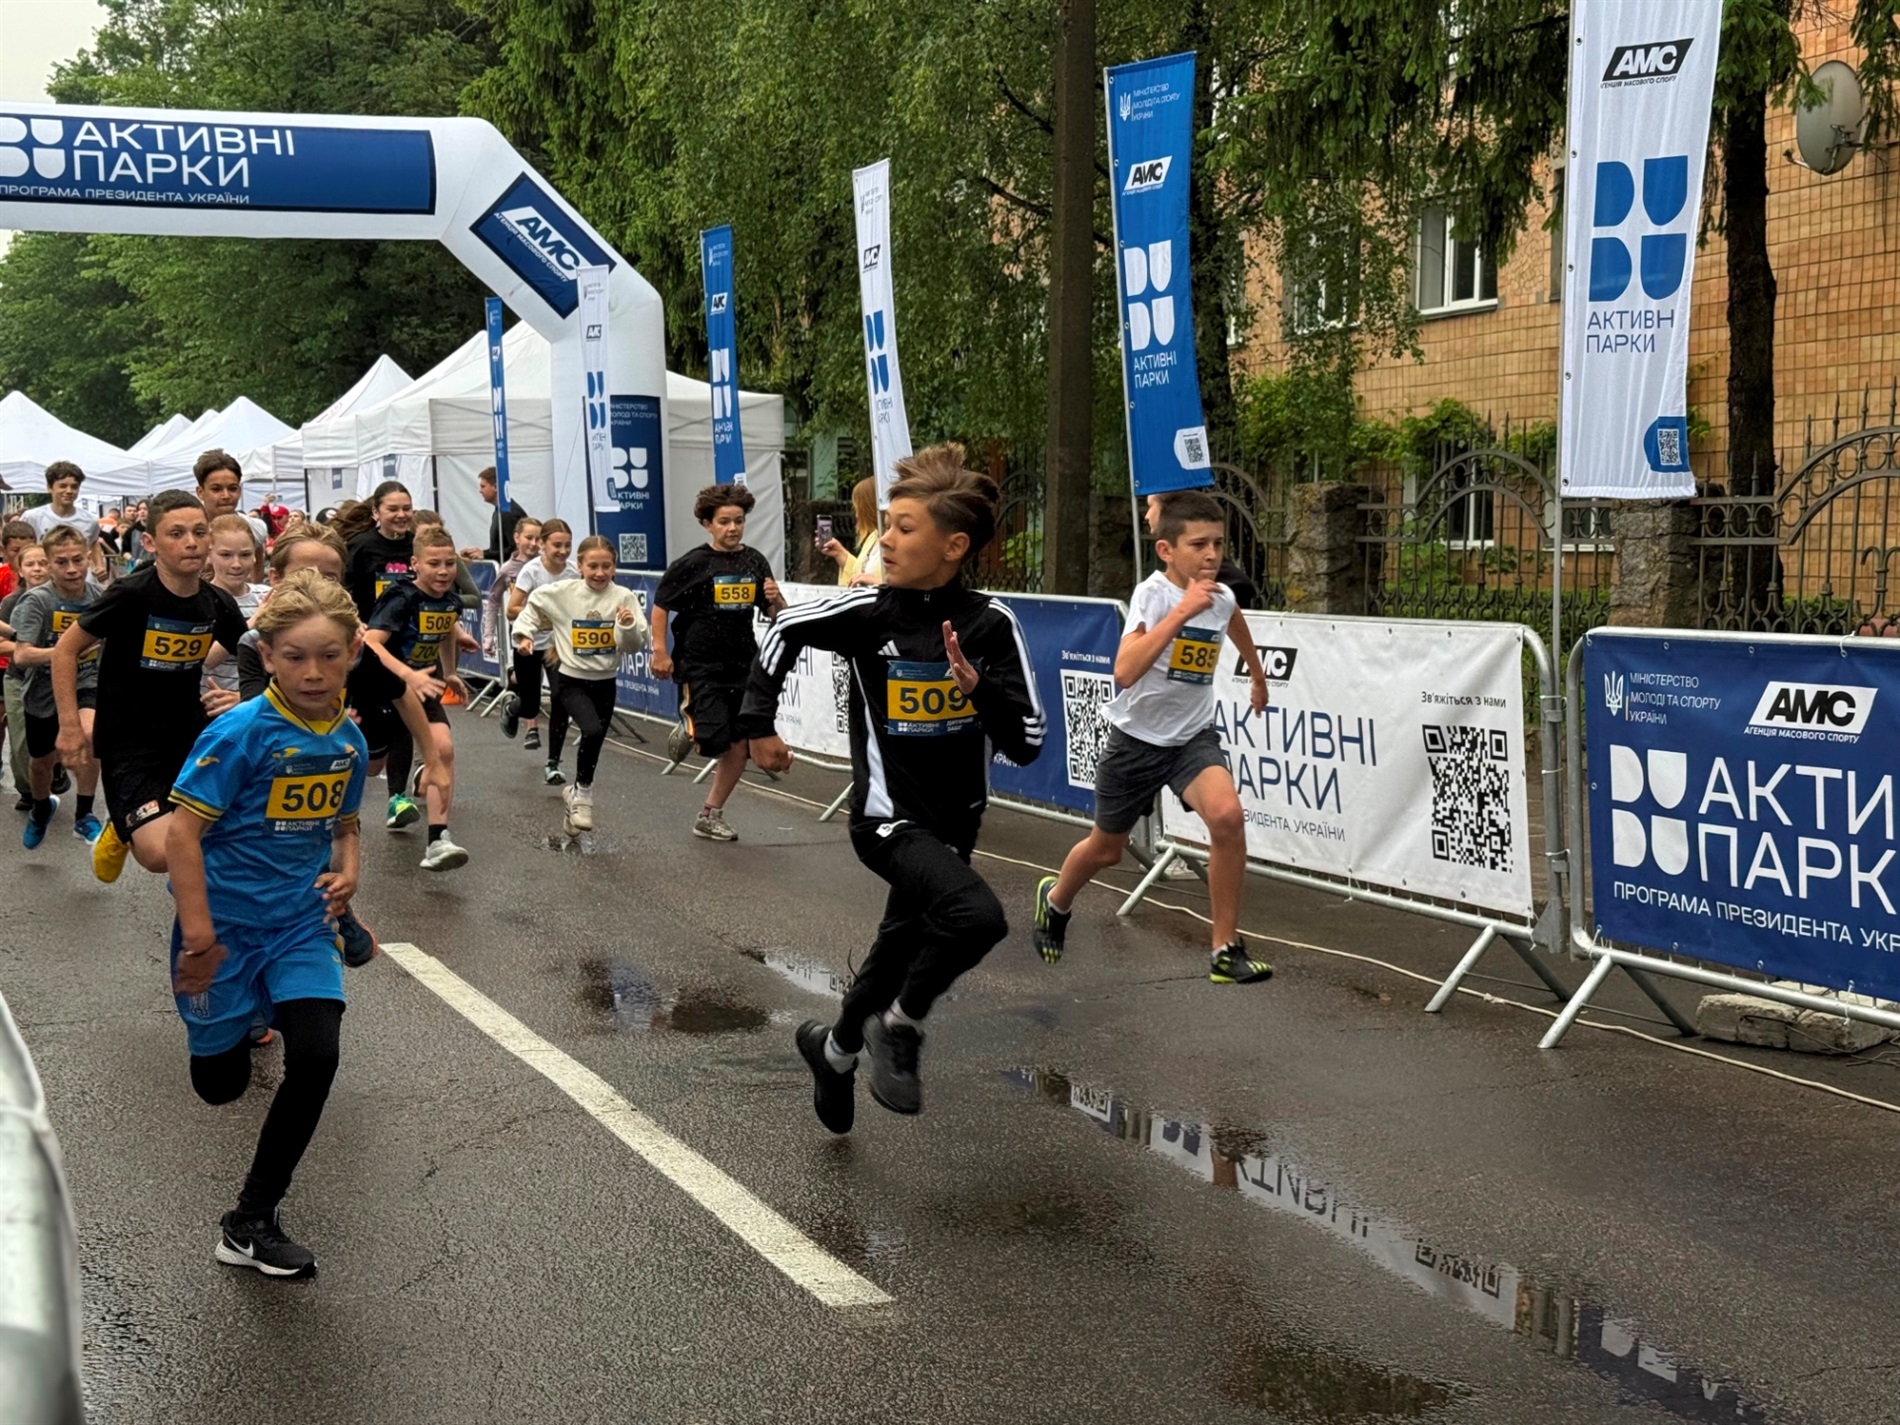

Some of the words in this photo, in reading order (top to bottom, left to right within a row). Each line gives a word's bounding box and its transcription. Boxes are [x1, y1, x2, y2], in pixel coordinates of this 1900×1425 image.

[1612, 44, 1678, 77] АМС
[73, 121, 295, 156] АКТИВНІ
[74, 149, 250, 188] ПАРКИ
[0, 184, 81, 199] ПРОГРАМА
[84, 188, 185, 203] ПРЕЗИДЕНТА
[187, 191, 250, 205] УКРАЇНИ
[514, 216, 580, 272] АМС
[1585, 333, 1656, 354] ПАРКИ
[1133, 350, 1178, 371] АКТИВНІ
[1134, 369, 1170, 389] ПАРКИ
[617, 490, 650, 501] КТИВНІ
[618, 501, 644, 511] АРКИ
[720, 586, 751, 601] 558
[425, 615, 452, 631] 508
[153, 635, 203, 658] 529
[577, 631, 612, 646] 590
[1179, 644, 1218, 669] 585
[1629, 672, 1700, 689] МІНІСТЕРСТВО
[899, 685, 968, 716] 509
[1421, 690, 1474, 706] Зв'яжіться
[1474, 695, 1482, 706] з
[1483, 696, 1507, 708] нами
[1630, 691, 1665, 707] МОЛОДІ
[1665, 693, 1680, 707] ТА
[1680, 695, 1722, 711] СПОРТУ
[1764, 687, 1857, 728] АМС
[1628, 709, 1668, 725] УКРАЇНИ
[1213, 699, 1377, 767] АКТИВНІ
[1743, 725, 1778, 738] АГЕНЦІЯ
[1778, 729, 1827, 742] МАСОВОГО
[1826, 731, 1860, 745] СПОРТУ
[281, 779, 345, 812] 508
[1293, 819, 1346, 843] УКРАЇНИ
[1613, 880, 1712, 918] ПРОГРАМА
[1716, 901, 1854, 945] ПРЕЗИДЕНТА
